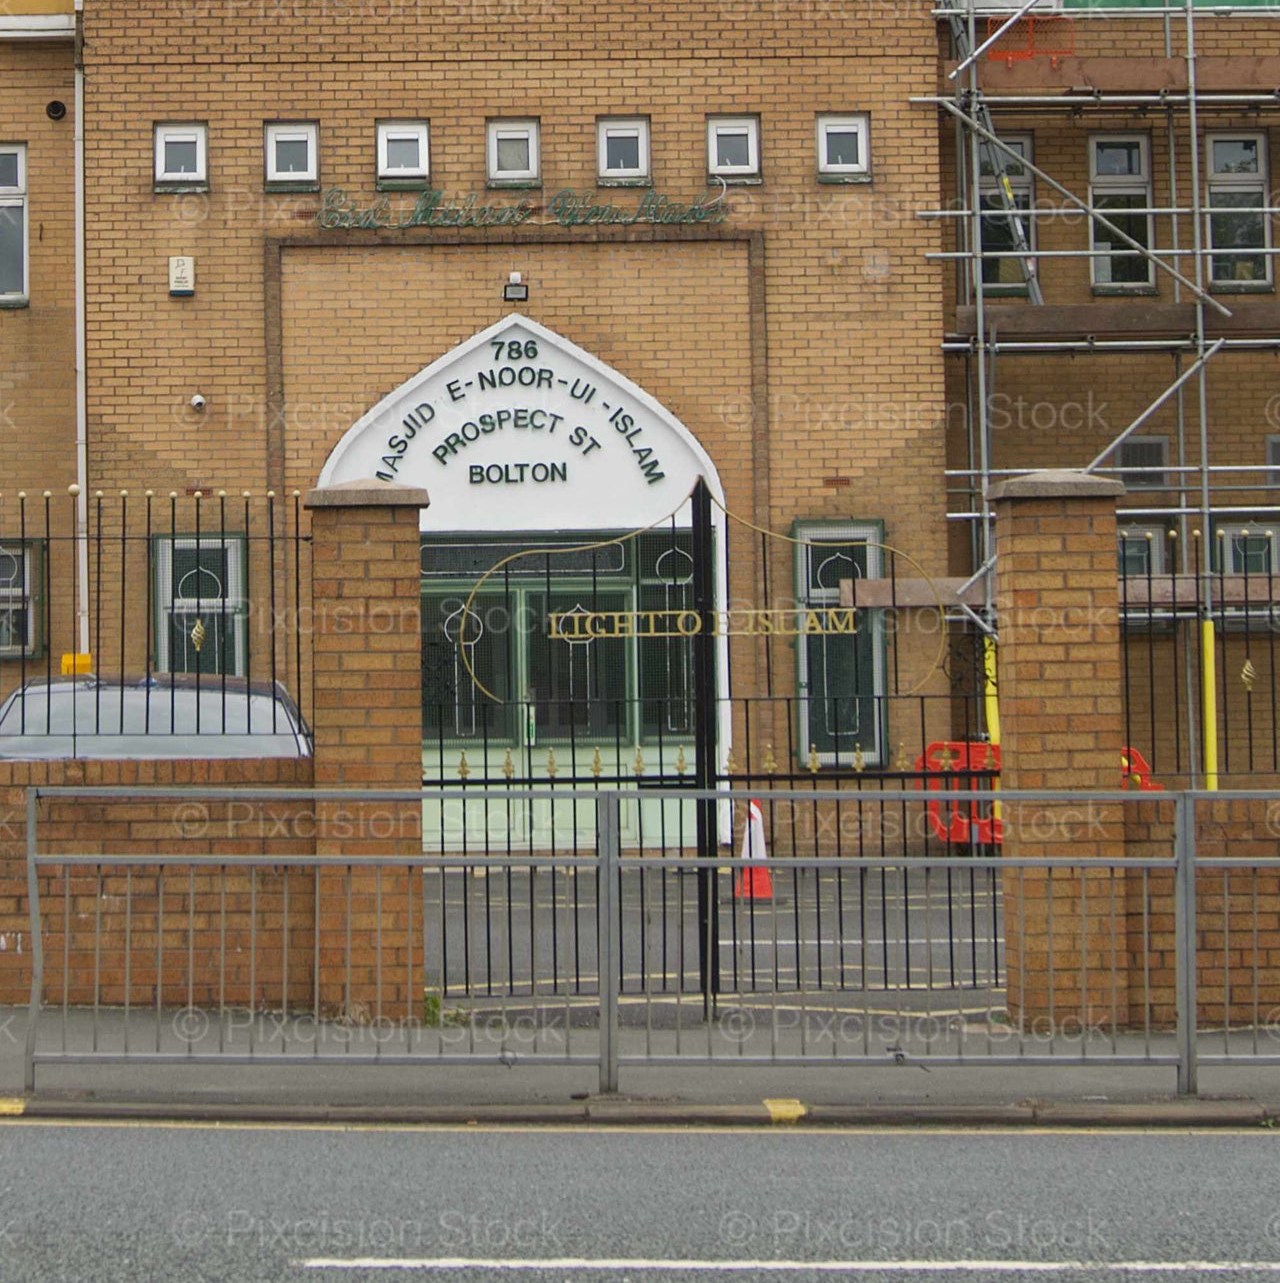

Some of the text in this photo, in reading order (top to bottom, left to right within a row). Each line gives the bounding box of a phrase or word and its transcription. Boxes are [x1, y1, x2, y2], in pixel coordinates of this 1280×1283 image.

[491, 340, 538, 361] 786
[431, 409, 602, 466] PROSPECT ST
[469, 462, 568, 484] BOLTON
[550, 612, 664, 639] LIGHT
[747, 608, 856, 635] ISLAM
